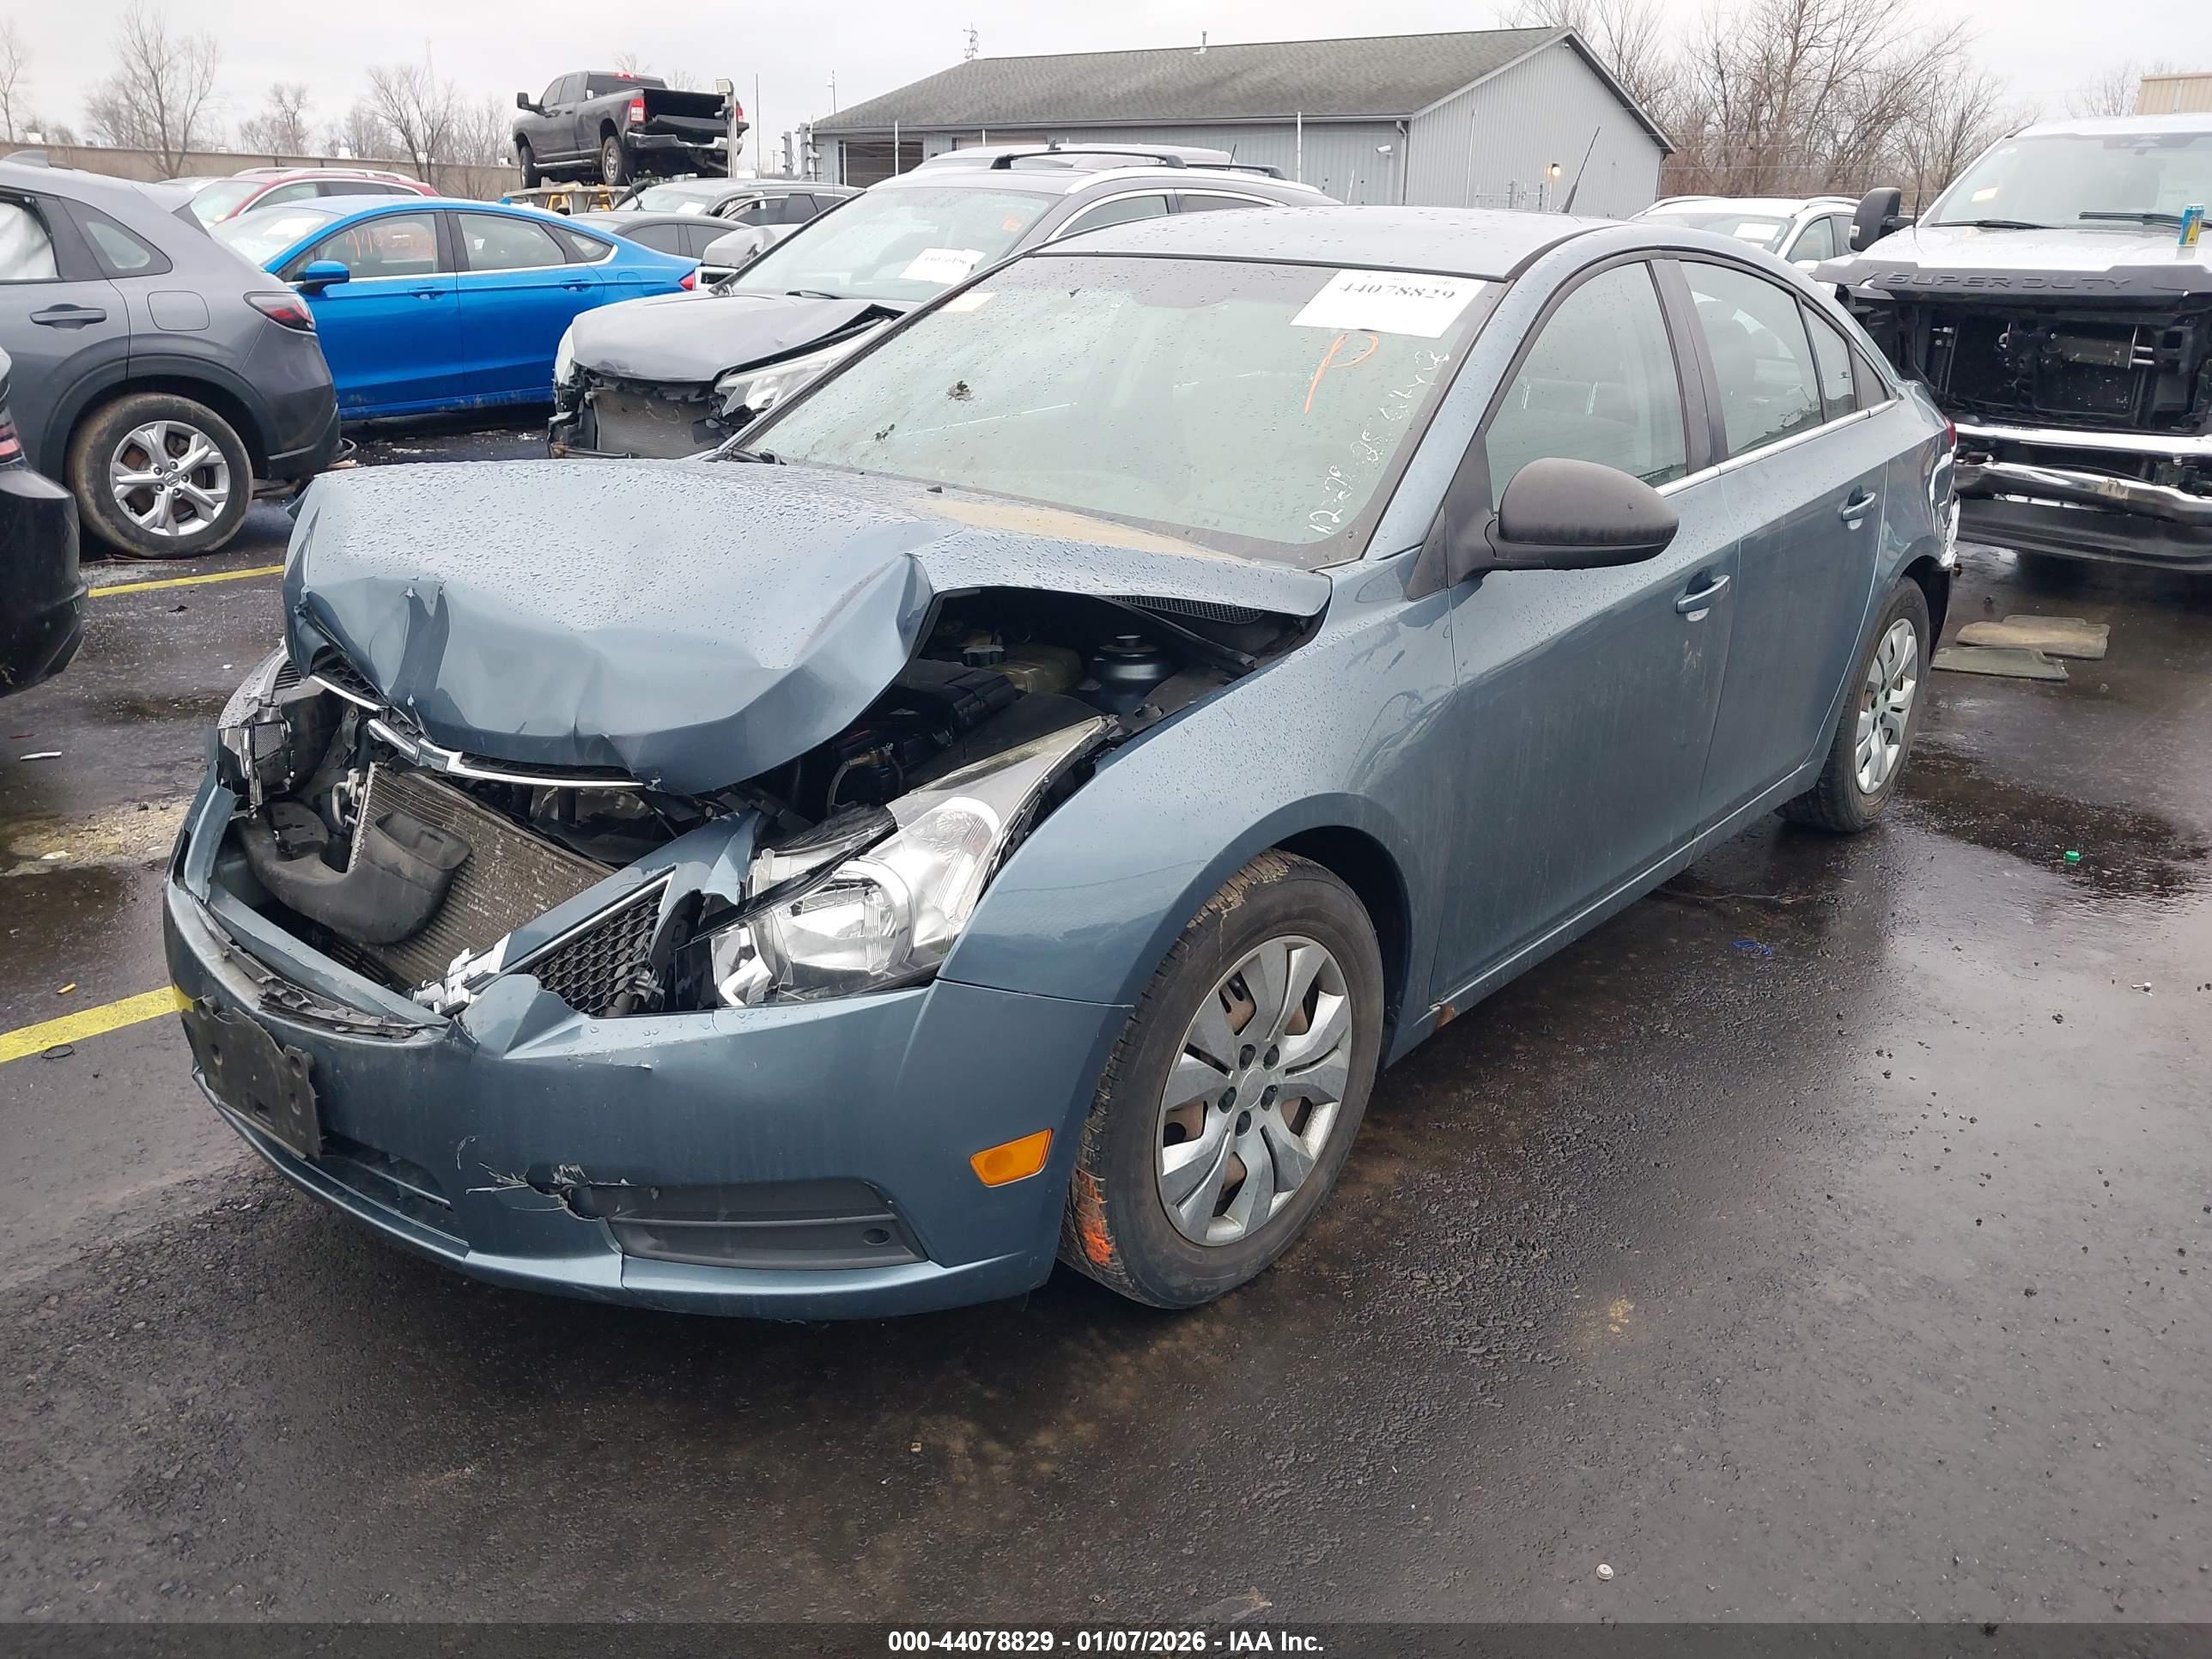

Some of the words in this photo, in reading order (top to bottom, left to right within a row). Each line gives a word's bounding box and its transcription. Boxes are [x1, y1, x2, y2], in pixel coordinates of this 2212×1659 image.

[1887, 272, 2014, 289] SUPER
[2021, 276, 2133, 290] DUTY
[1339, 282, 1456, 299] 44078829
